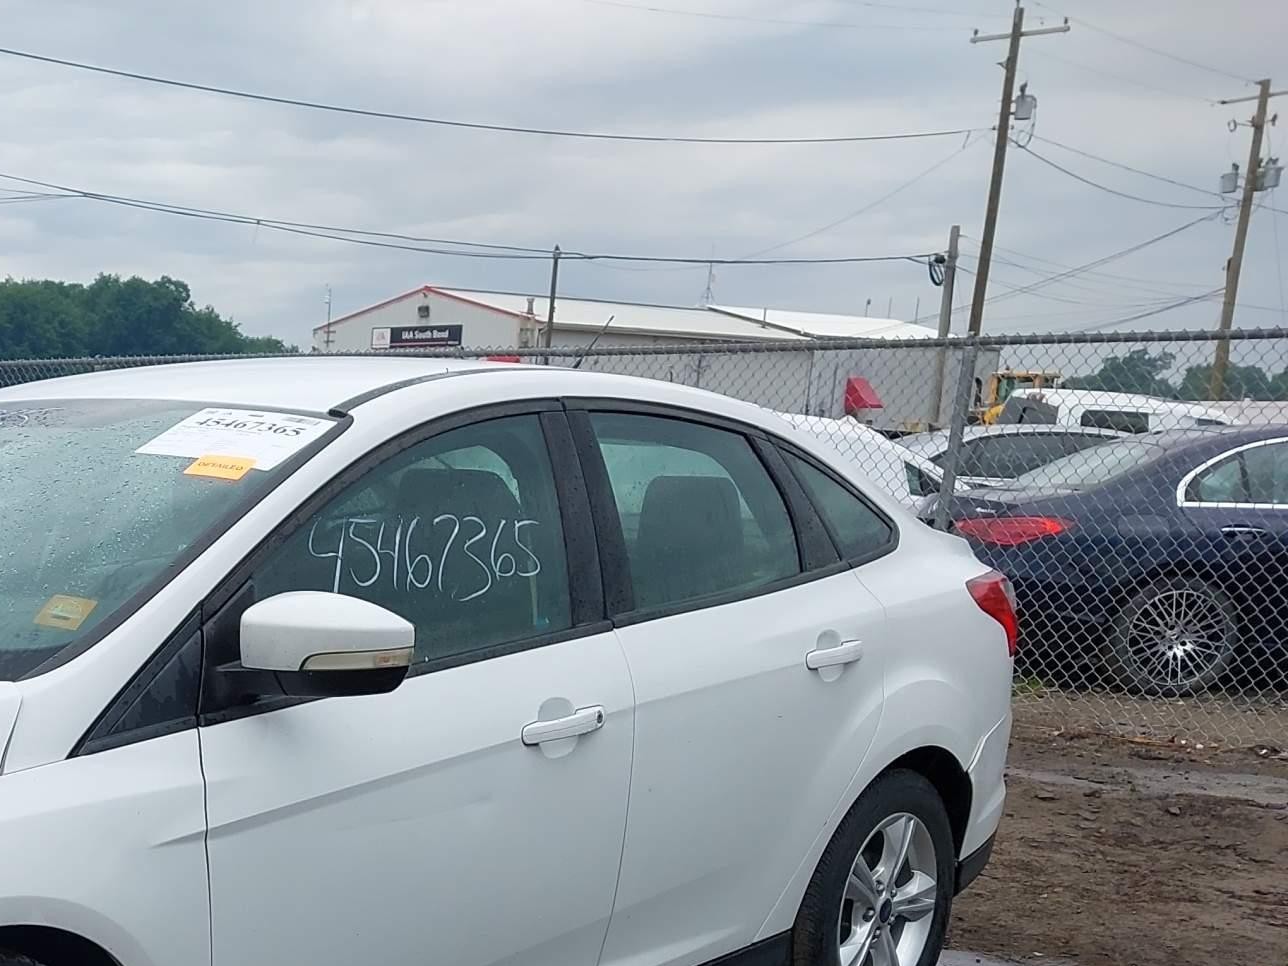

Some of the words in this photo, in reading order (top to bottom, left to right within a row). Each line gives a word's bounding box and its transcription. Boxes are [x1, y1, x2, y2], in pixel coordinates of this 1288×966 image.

[414, 329, 432, 339] South
[432, 328, 449, 339] Bend
[195, 417, 307, 438] 45467365
[197, 461, 244, 472] DETAILED
[308, 514, 541, 602] 45467365
